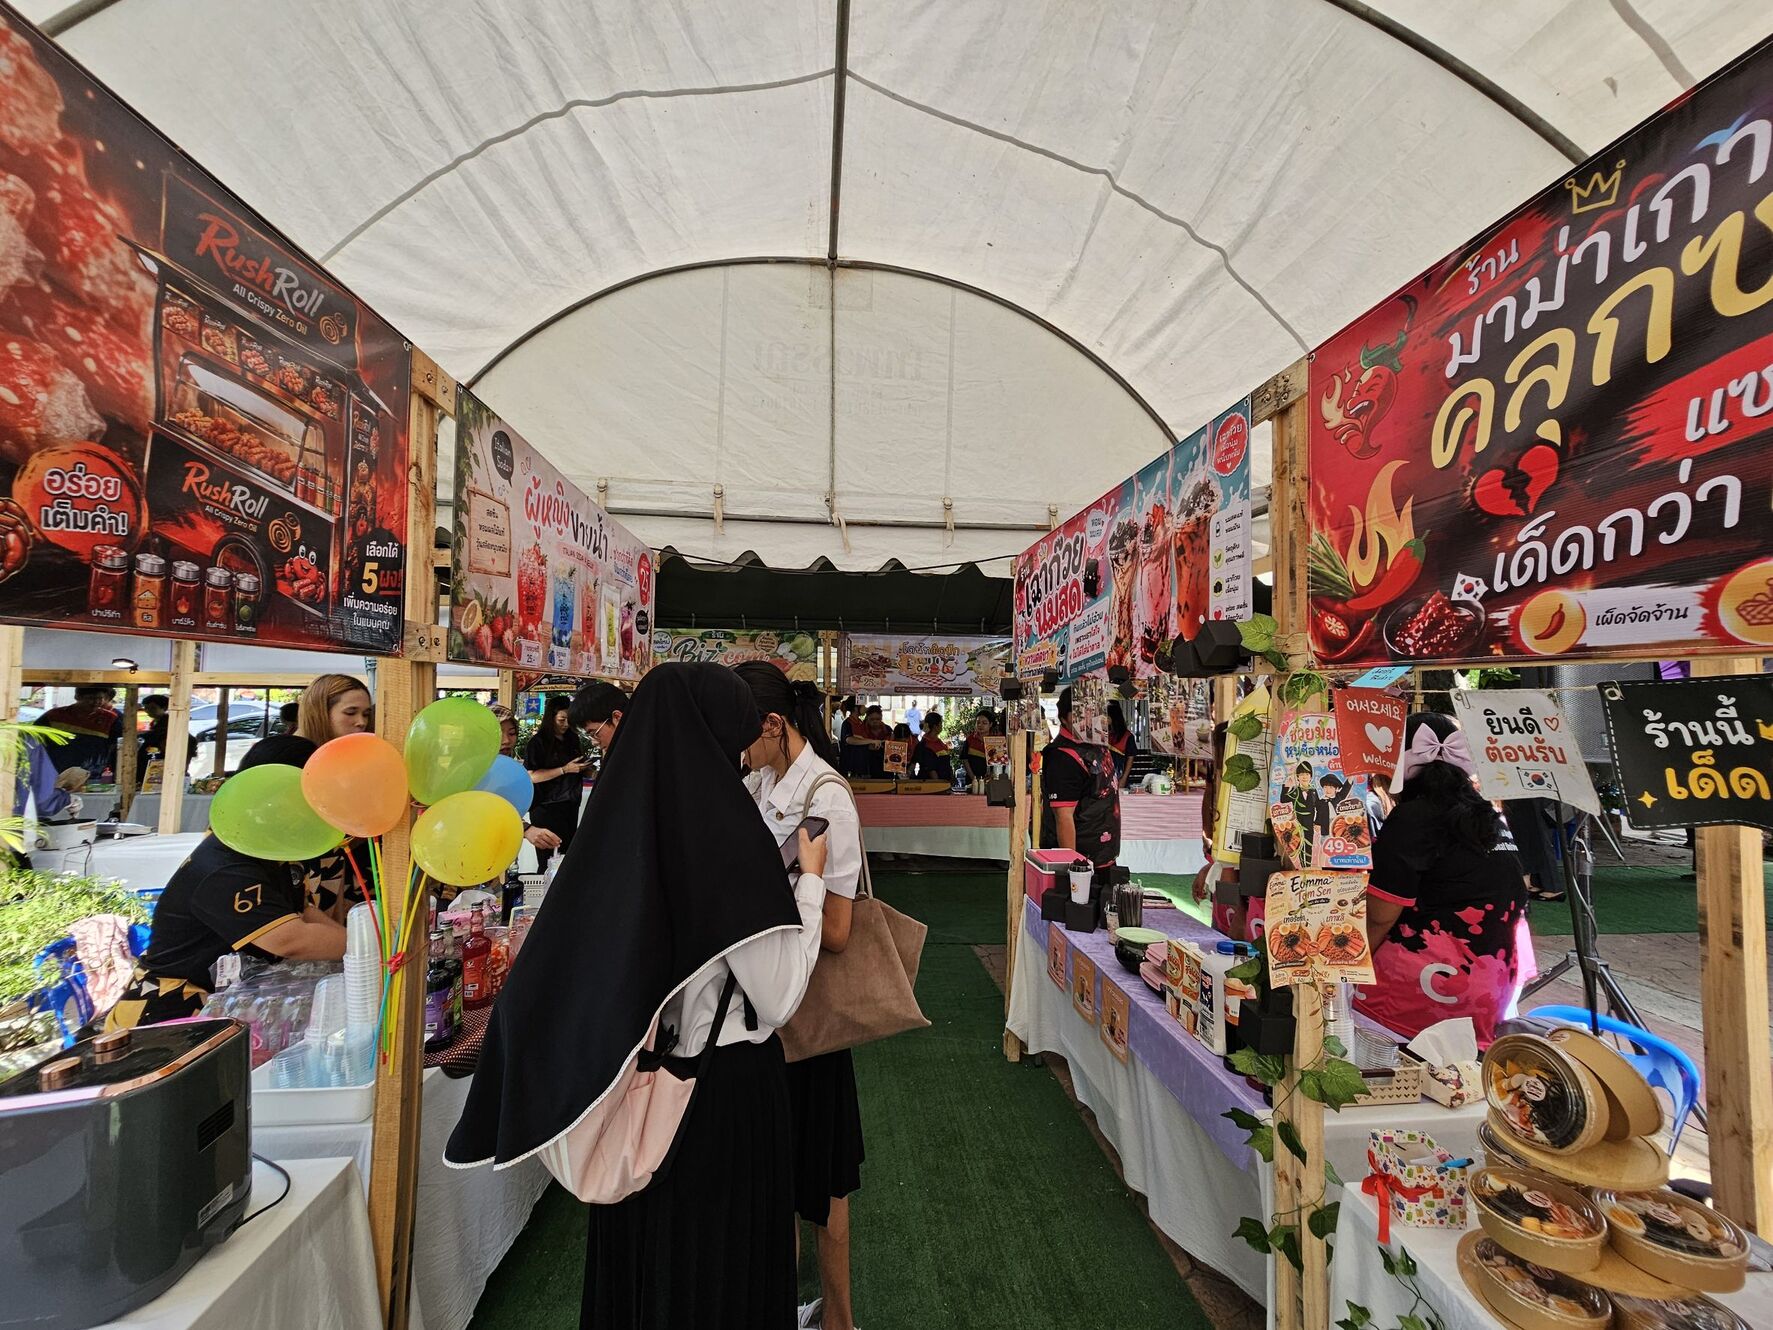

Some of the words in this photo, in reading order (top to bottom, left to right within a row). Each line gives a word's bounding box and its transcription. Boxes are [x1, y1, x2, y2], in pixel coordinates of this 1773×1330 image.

[1465, 237, 1519, 296] ร้าน
[233, 284, 246, 298] All
[247, 292, 275, 318] Crispy
[275, 309, 295, 327] Zero
[296, 321, 308, 335] Oil
[43, 464, 121, 500] อร่อย
[182, 461, 269, 519] RushRoll
[40, 500, 128, 535] เต็มคำ!
[205, 505, 216, 514] All
[214, 508, 234, 523] Crispy
[234, 516, 248, 529] Zero
[1494, 459, 1743, 593] เด็ดกว่า
[366, 541, 399, 559] เลือกได้
[361, 562, 379, 594] 5
[1024, 532, 1086, 617] เฉาก๊วย
[343, 593, 398, 616] เพิ่มความอร่อย
[1035, 579, 1083, 640] นมสด
[1595, 603, 1689, 627] เผ็ดจัดจ้าน
[353, 612, 390, 632] ในแบบคุณ
[1346, 700, 1401, 721] 어서오세요
[1484, 706, 1542, 736] ยินดี
[1642, 694, 1755, 749] ร้านนี้
[1362, 752, 1398, 770] Welcom
[1485, 736, 1568, 765] ต้อนรับ
[1664, 748, 1772, 801] เด็ด
[1324, 839, 1356, 853] 49.-
[233, 884, 262, 912] 67
[1291, 876, 1331, 893] Eomma
